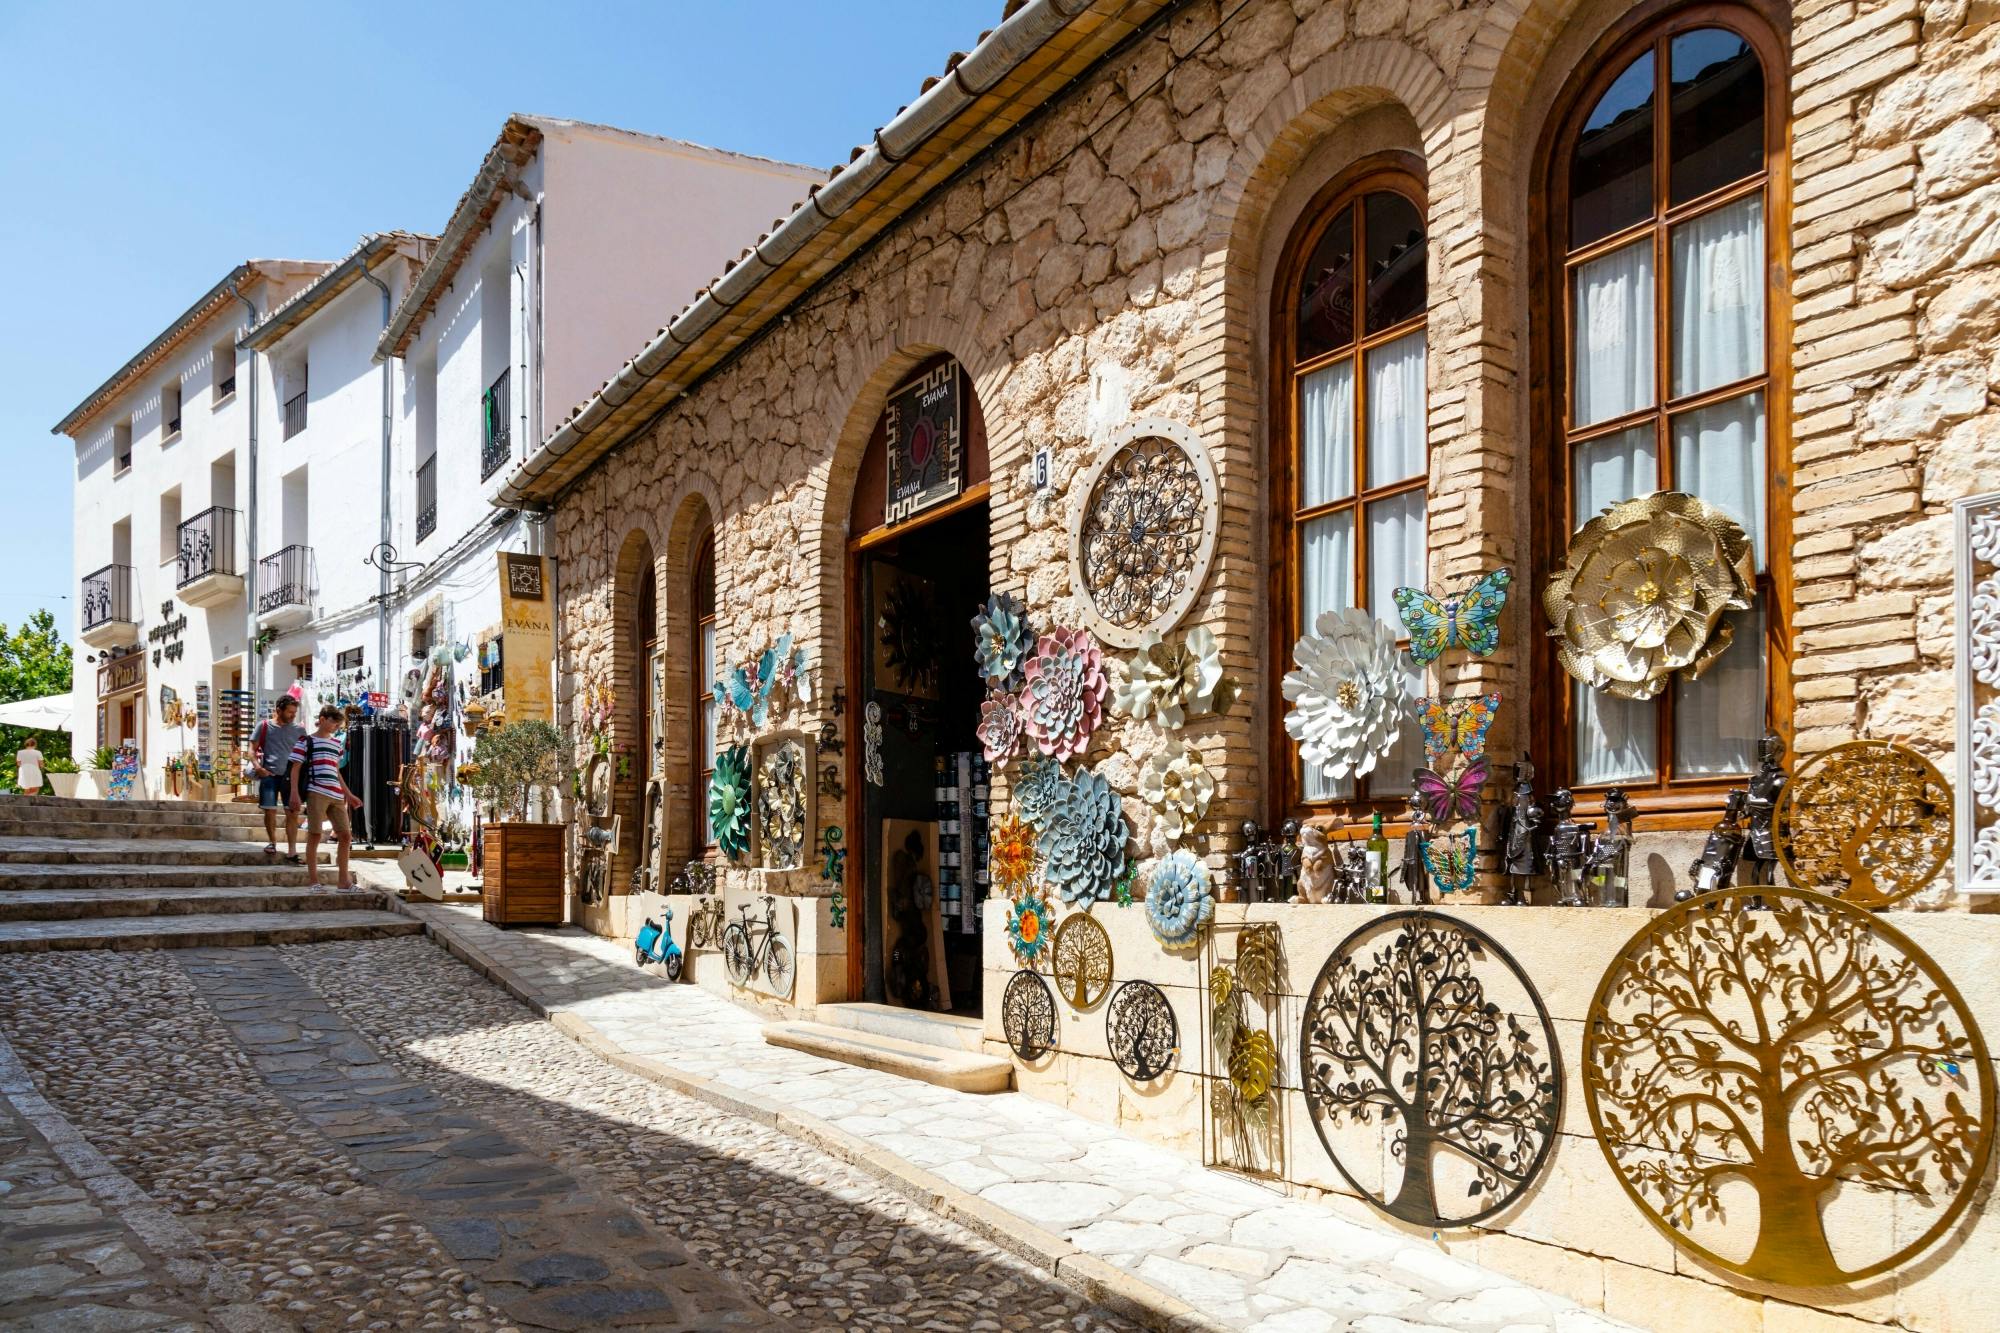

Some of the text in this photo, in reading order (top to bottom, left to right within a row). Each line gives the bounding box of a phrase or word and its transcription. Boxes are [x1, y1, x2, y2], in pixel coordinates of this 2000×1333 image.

[922, 383, 948, 408] EVANA
[1037, 457, 1046, 484] 6
[896, 480, 921, 500] EVANA
[507, 618, 550, 631] EVANA
[115, 665, 135, 687] Plaza
